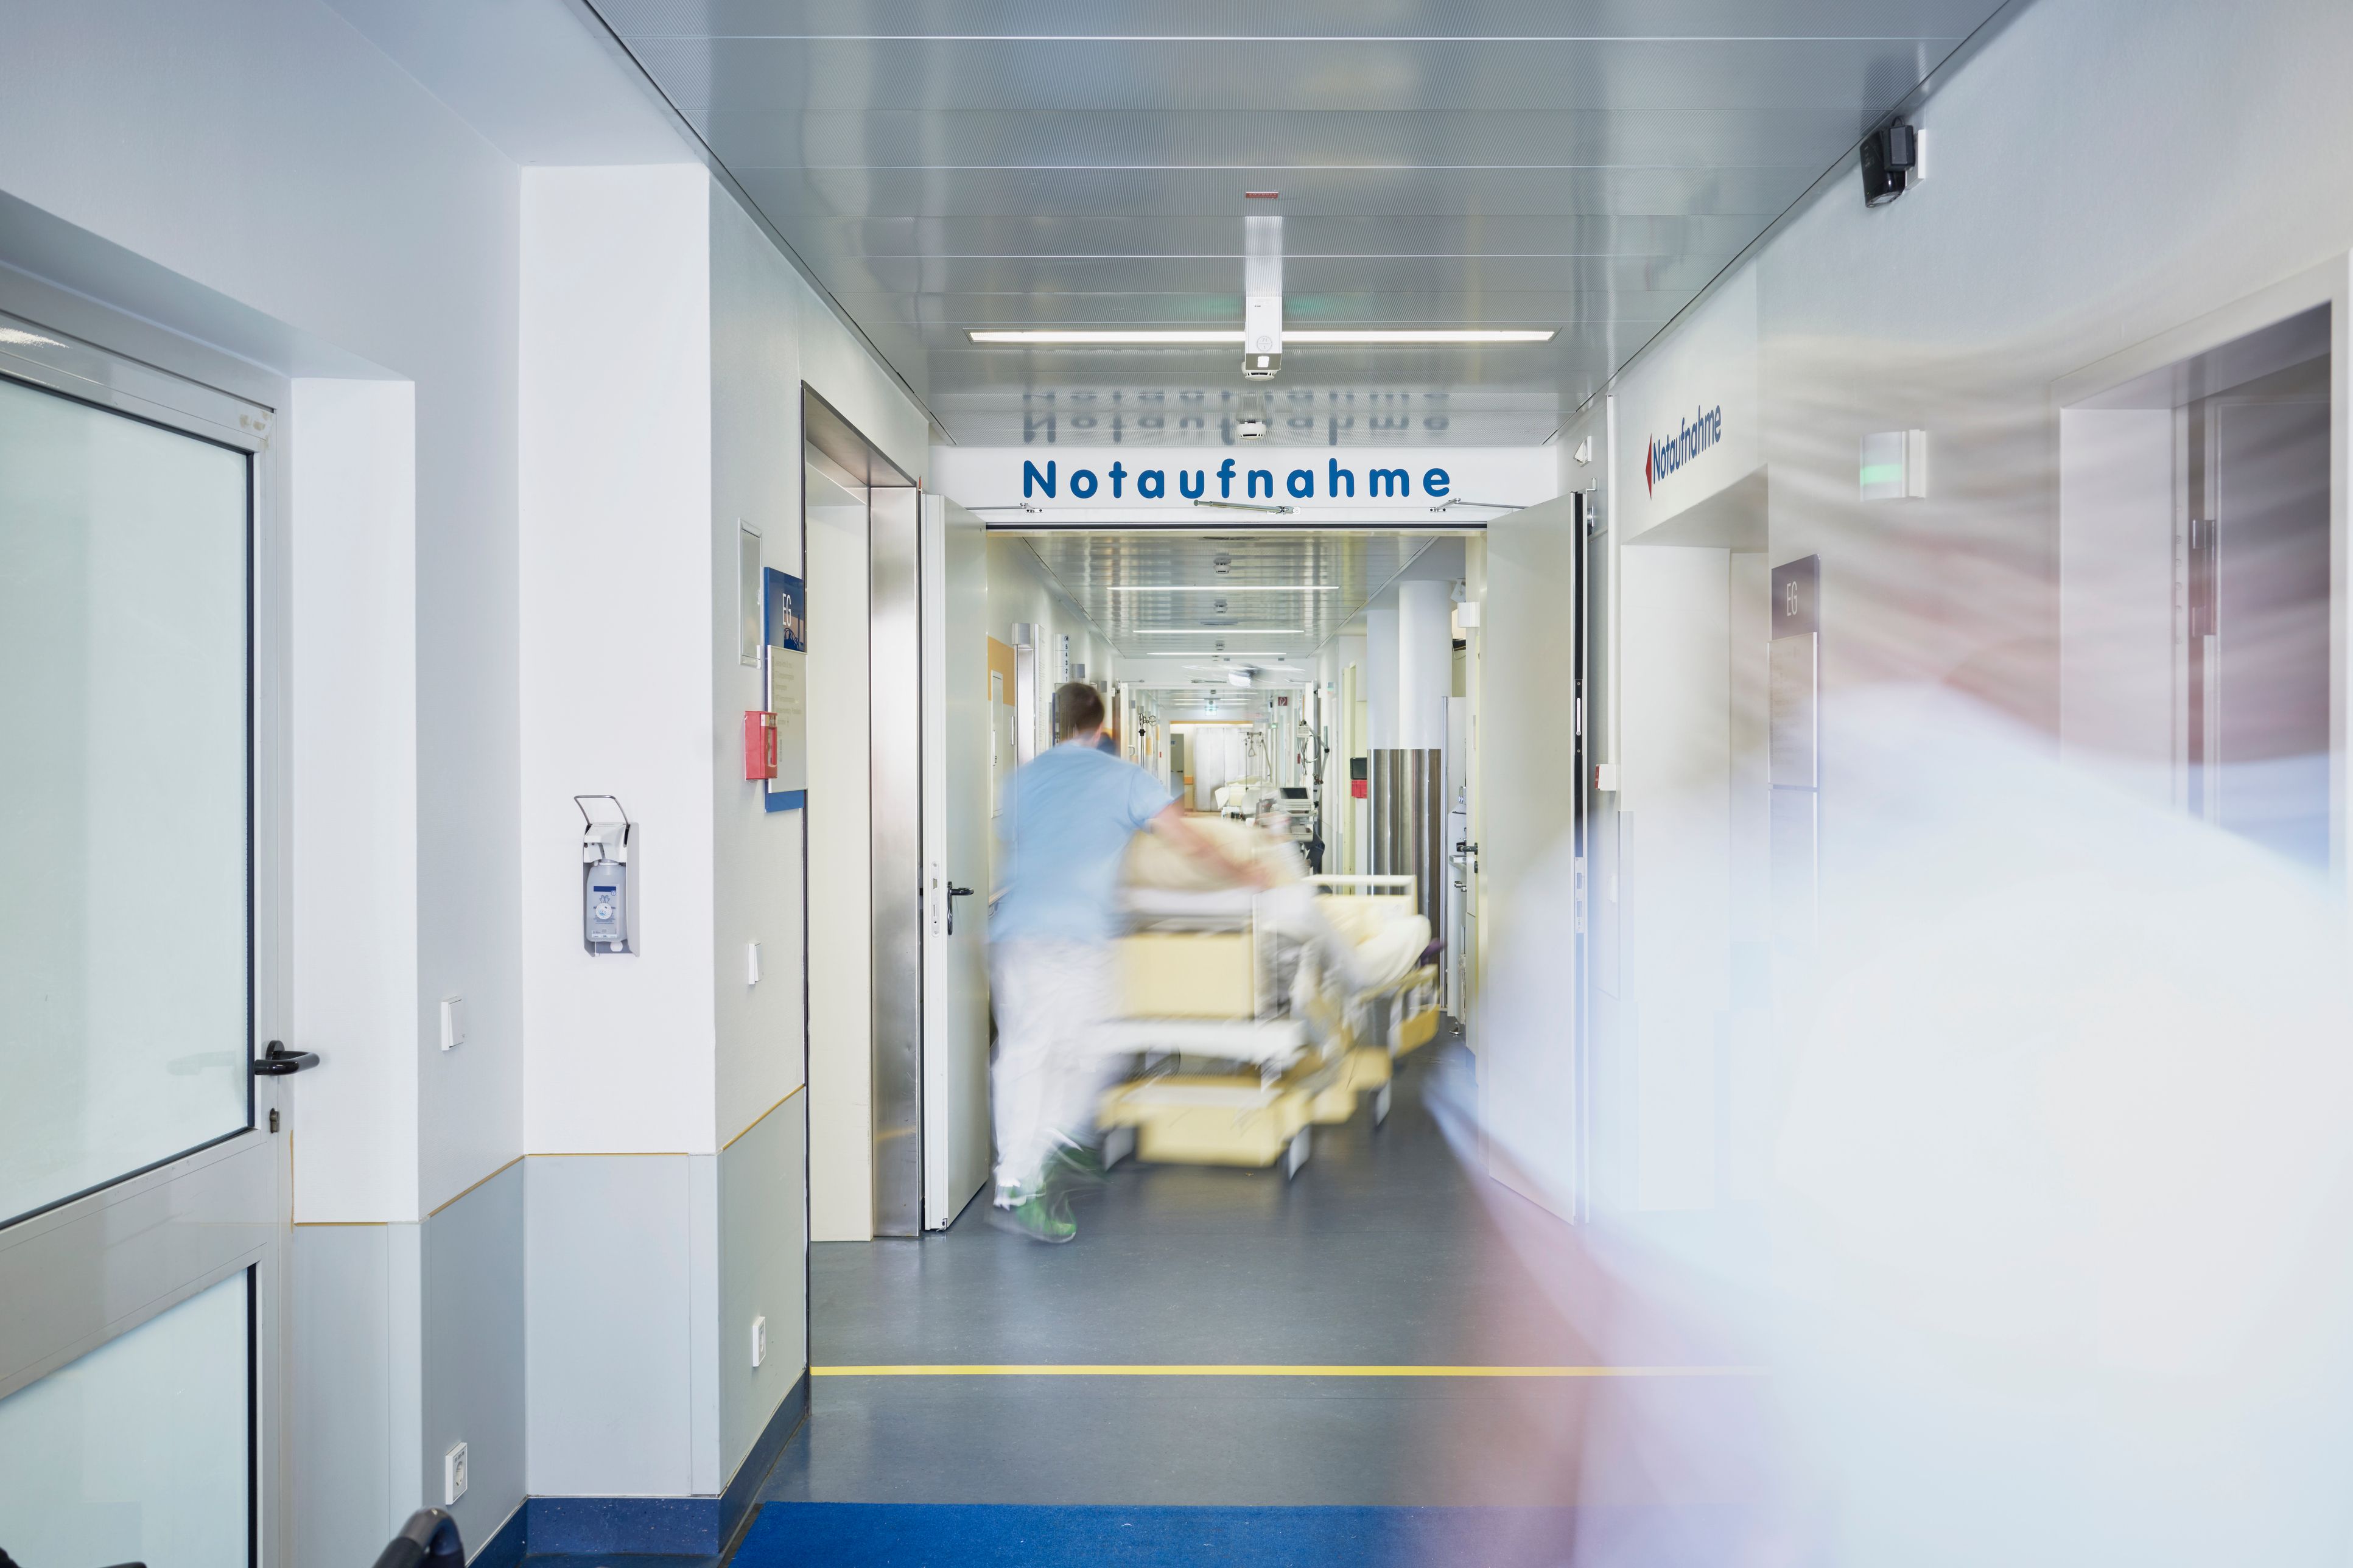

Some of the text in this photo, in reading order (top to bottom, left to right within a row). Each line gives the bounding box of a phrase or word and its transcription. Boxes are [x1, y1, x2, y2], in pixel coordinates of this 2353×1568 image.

[1653, 405, 1721, 485] Notaufnahme
[1023, 458, 1450, 499] Notaufnahme
[782, 593, 791, 627] EG
[1787, 581, 1798, 617] EG
